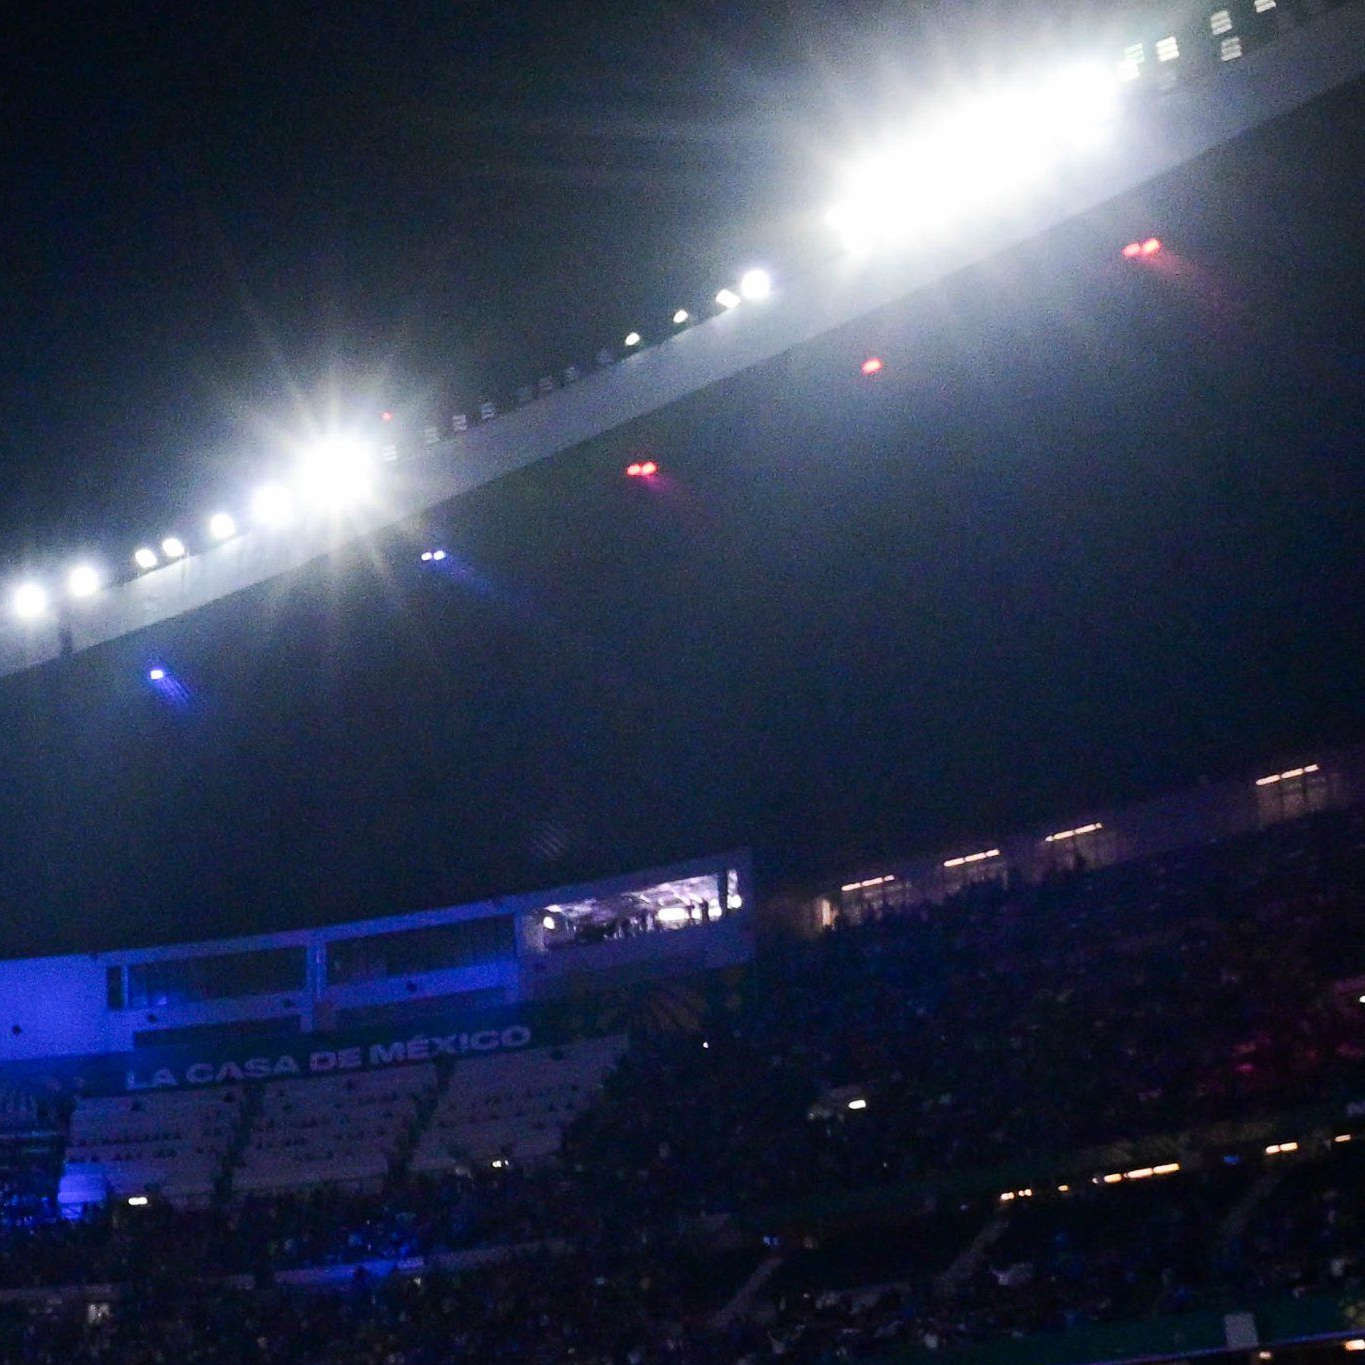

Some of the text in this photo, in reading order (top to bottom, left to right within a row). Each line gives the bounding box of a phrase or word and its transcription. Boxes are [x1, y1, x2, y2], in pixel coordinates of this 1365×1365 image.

[127, 1068, 178, 1091] LA
[186, 1055, 300, 1084] CASA
[309, 1047, 362, 1073] DE
